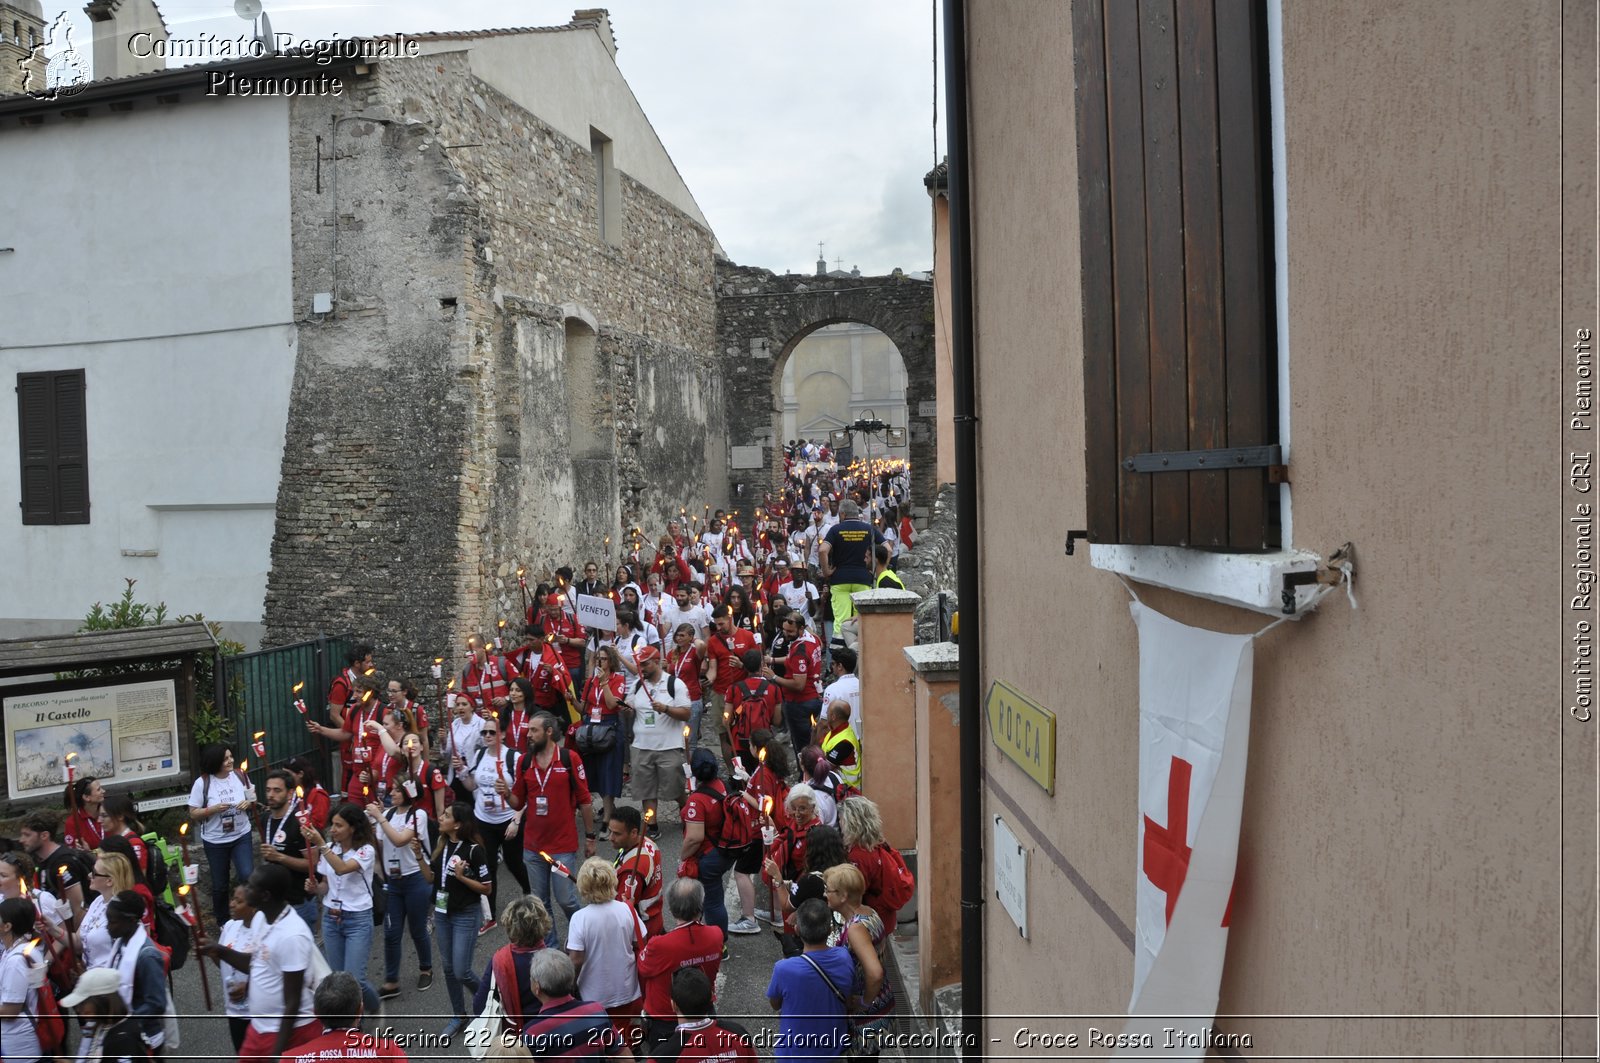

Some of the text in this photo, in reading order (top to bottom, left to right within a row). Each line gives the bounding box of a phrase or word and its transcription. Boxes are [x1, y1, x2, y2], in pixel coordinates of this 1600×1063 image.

[580, 603, 610, 617] VENETO
[13, 700, 49, 709] PERCORSO
[36, 707, 91, 722] Il Castello
[999, 699, 1040, 768] ROCCA
[320, 1050, 342, 1061] ROSSA
[347, 1048, 377, 1059] ITALIANA
